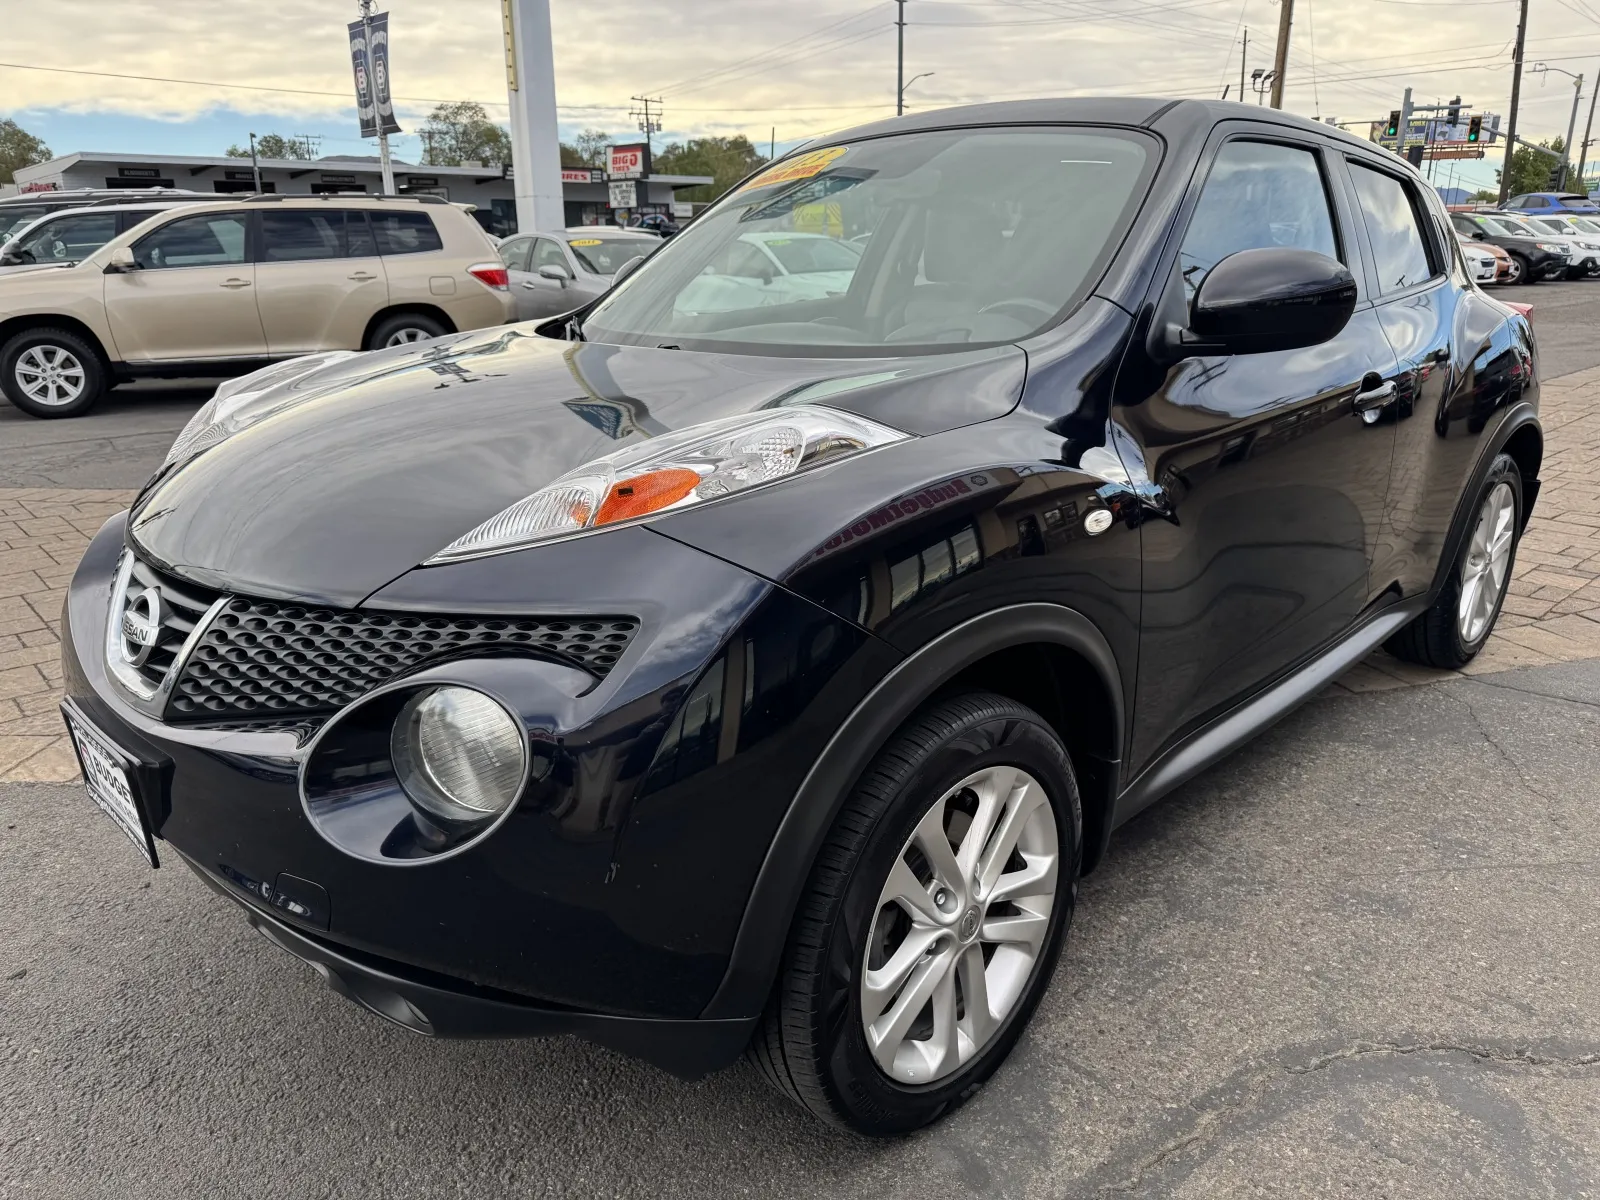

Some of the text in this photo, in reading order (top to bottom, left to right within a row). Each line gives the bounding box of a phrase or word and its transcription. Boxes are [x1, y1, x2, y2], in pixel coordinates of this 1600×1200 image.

[612, 155, 629, 166] BIG
[612, 165, 630, 173] TIRES
[561, 171, 588, 181] IRES
[123, 620, 149, 642] SSAN
